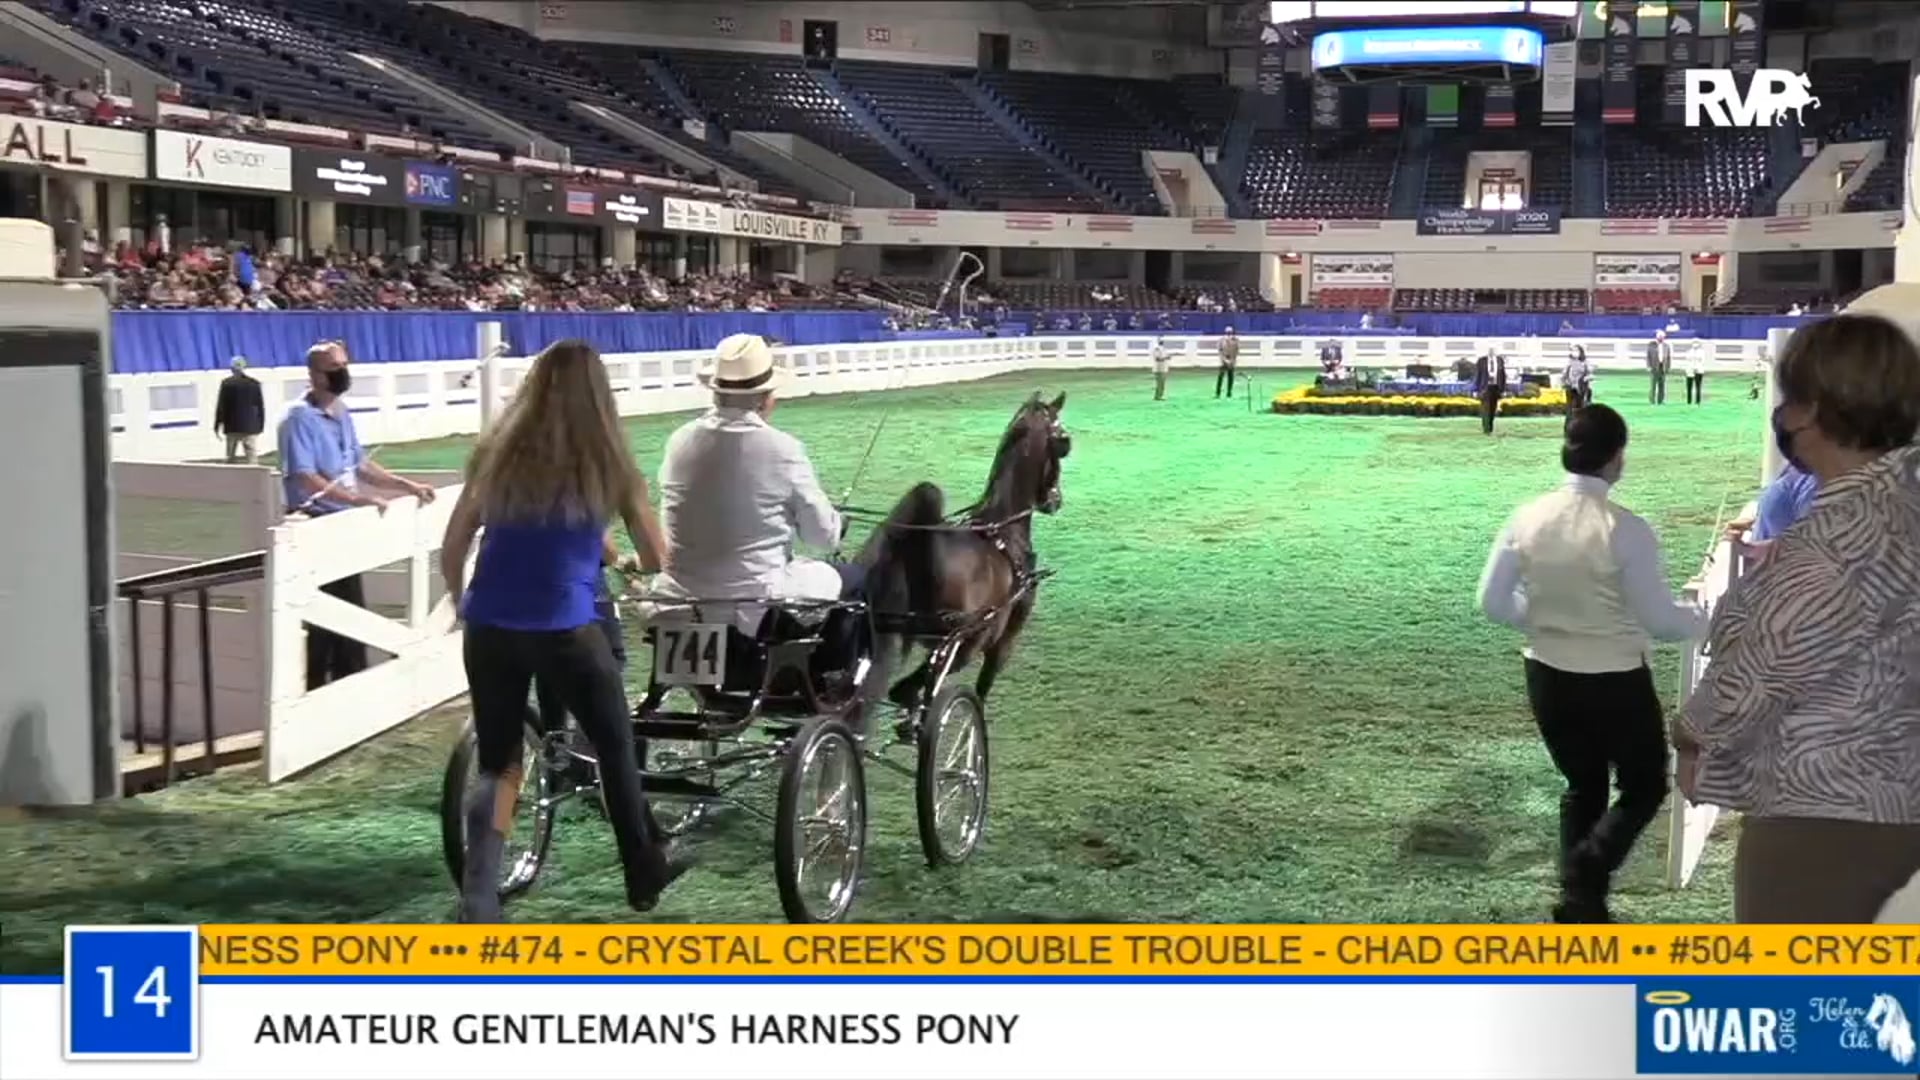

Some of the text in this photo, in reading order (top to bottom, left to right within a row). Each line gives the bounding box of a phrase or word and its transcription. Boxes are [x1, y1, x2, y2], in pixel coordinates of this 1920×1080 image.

[4, 122, 87, 166] ALL
[419, 174, 451, 199] PNC
[733, 212, 807, 239] LOUISVILLE
[813, 219, 829, 240] KY
[1516, 212, 1549, 222] 2020
[665, 631, 718, 674] 744
